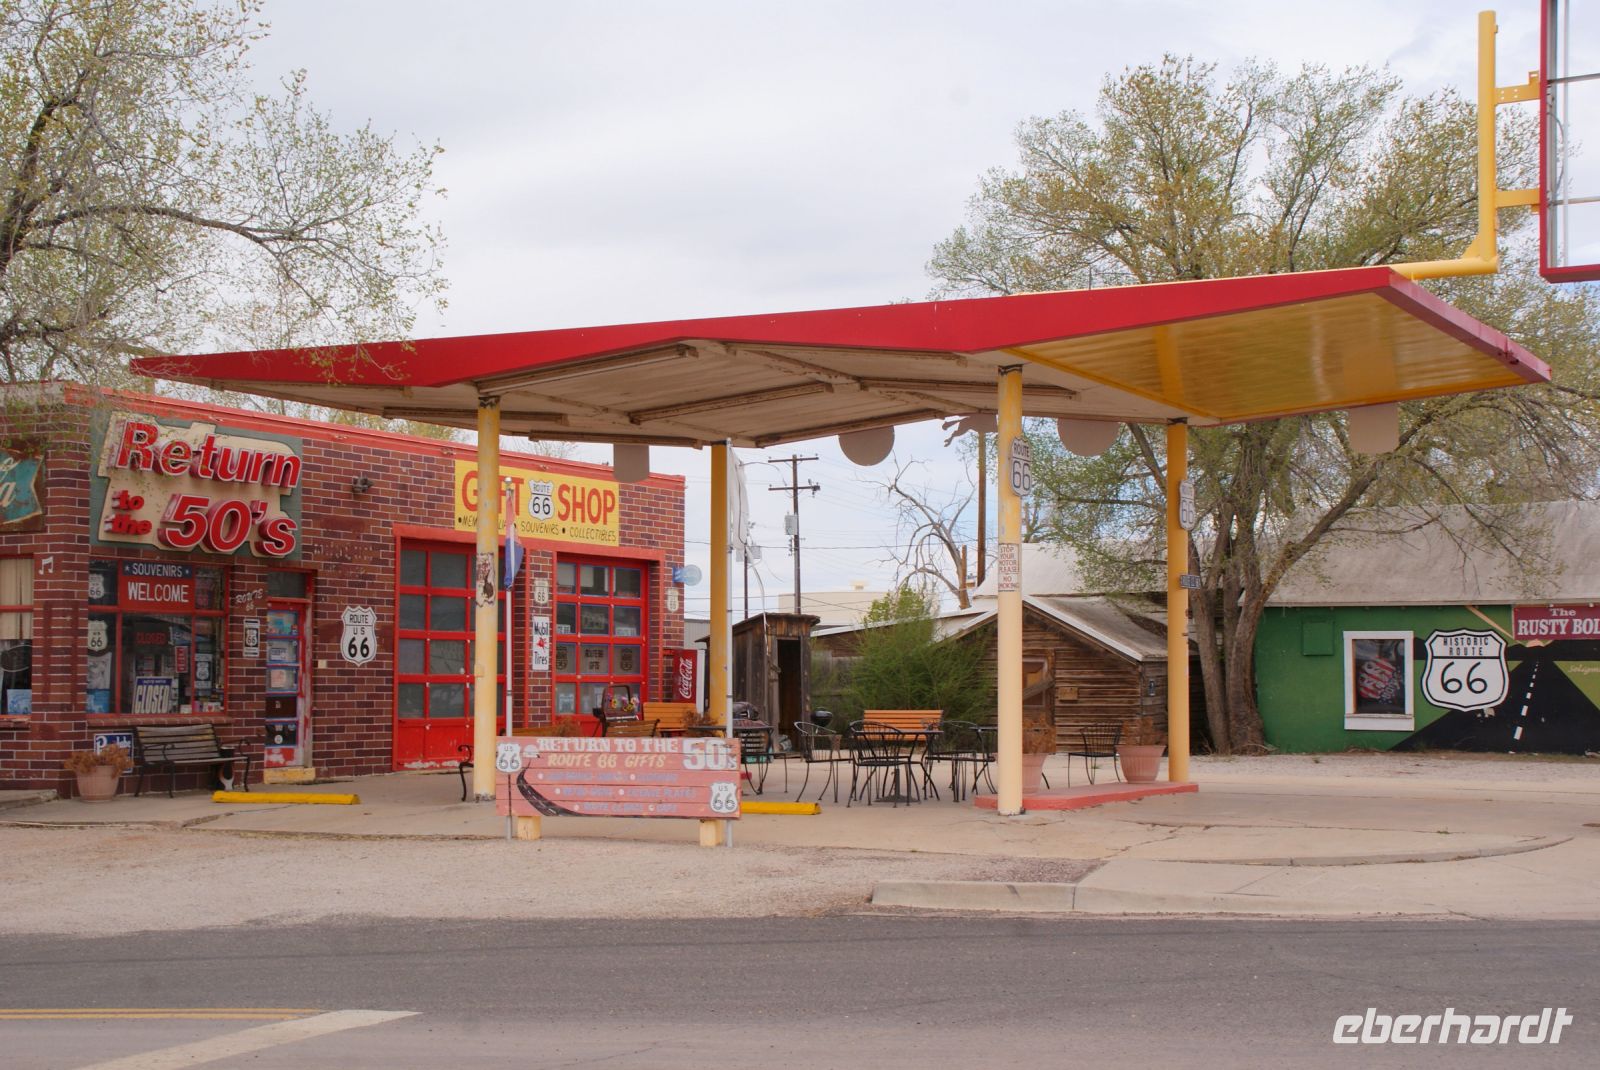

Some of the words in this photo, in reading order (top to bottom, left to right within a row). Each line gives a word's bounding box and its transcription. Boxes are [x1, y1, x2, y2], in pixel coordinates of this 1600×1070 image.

[114, 420, 301, 488] Return
[1013, 443, 1029, 458] ROUTE
[1012, 460, 1031, 491] 66
[533, 483, 551, 493] ROUTE
[114, 490, 145, 511] to
[461, 470, 525, 516] GFT
[557, 483, 616, 526] SHOP
[532, 496, 551, 515] 66
[108, 513, 152, 536] the
[163, 494, 298, 556] 50's
[521, 520, 559, 536] SOUVENIRS
[569, 526, 617, 542] COLLECTIBLES
[131, 562, 183, 578] SOUVENIRS
[128, 581, 189, 603] WELCOME
[349, 614, 369, 624] ROUTE
[1550, 608, 1577, 617] The
[1518, 619, 1570, 636] RUSTY
[90, 637, 103, 648] 66
[347, 636, 370, 658] 66
[1442, 637, 1489, 646] HISTORIC
[534, 651, 548, 665] Tires
[1449, 647, 1484, 656] ROUTE
[1440, 661, 1488, 694] 66
[135, 684, 171, 714] CLOSED
[537, 738, 611, 752] RETURN
[612, 738, 637, 753] TO
[641, 738, 679, 753] THE
[499, 753, 520, 770] 66
[547, 753, 592, 767] ROUTE
[598, 754, 617, 768] 66
[624, 754, 666, 768] GIFTS
[712, 793, 736, 811] 66
